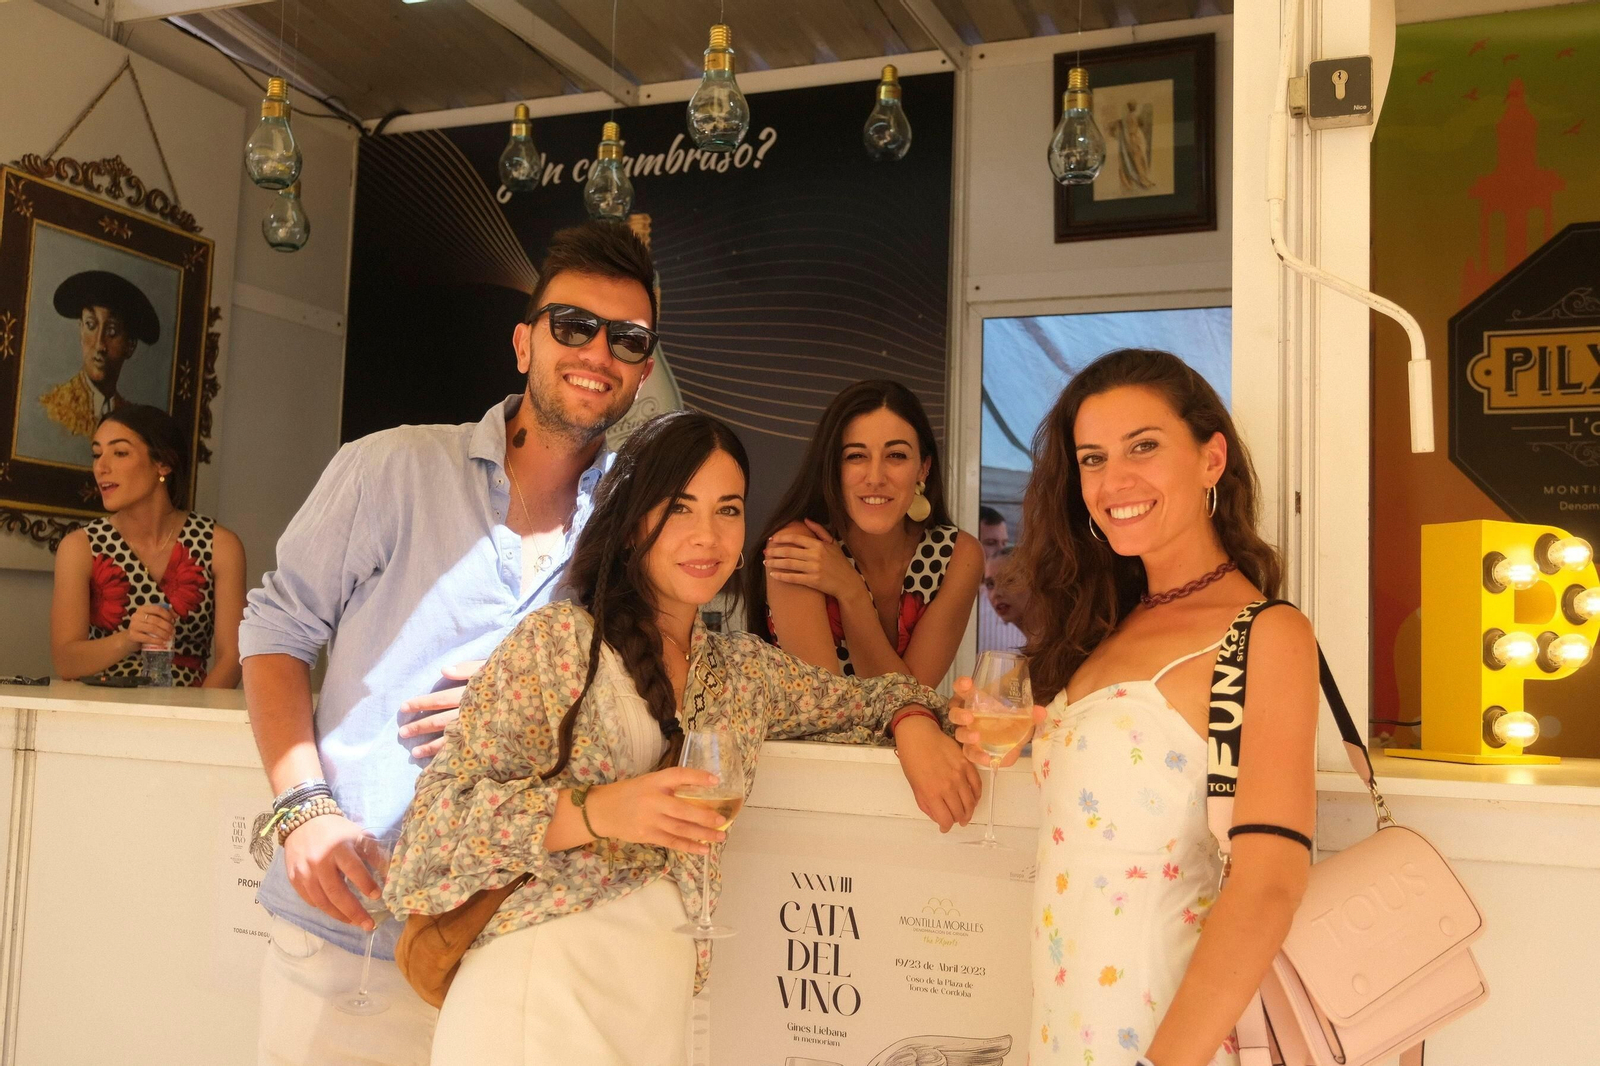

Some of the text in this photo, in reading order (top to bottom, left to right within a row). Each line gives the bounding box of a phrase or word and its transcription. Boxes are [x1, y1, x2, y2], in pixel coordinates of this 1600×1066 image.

[1236, 628, 1248, 662] TOUS
[1207, 664, 1244, 779] FUN
[791, 871, 852, 893] XXXVIII
[1311, 861, 1427, 948] TOUS
[779, 900, 860, 940] CATA
[899, 915, 942, 929] MONTILLA
[787, 938, 852, 978] DEL
[895, 958, 986, 976] 19/23 de Abril 2023
[905, 974, 925, 983] Coso
[926, 977, 935, 985] de
[944, 979, 963, 988] Plaza
[964, 981, 974, 989] de
[909, 984, 929, 993] Toros
[930, 986, 939, 994] de
[777, 975, 861, 1017] VINO
[786, 1021, 847, 1038] Gines Liebana
[793, 1034, 840, 1047] in memoriam
